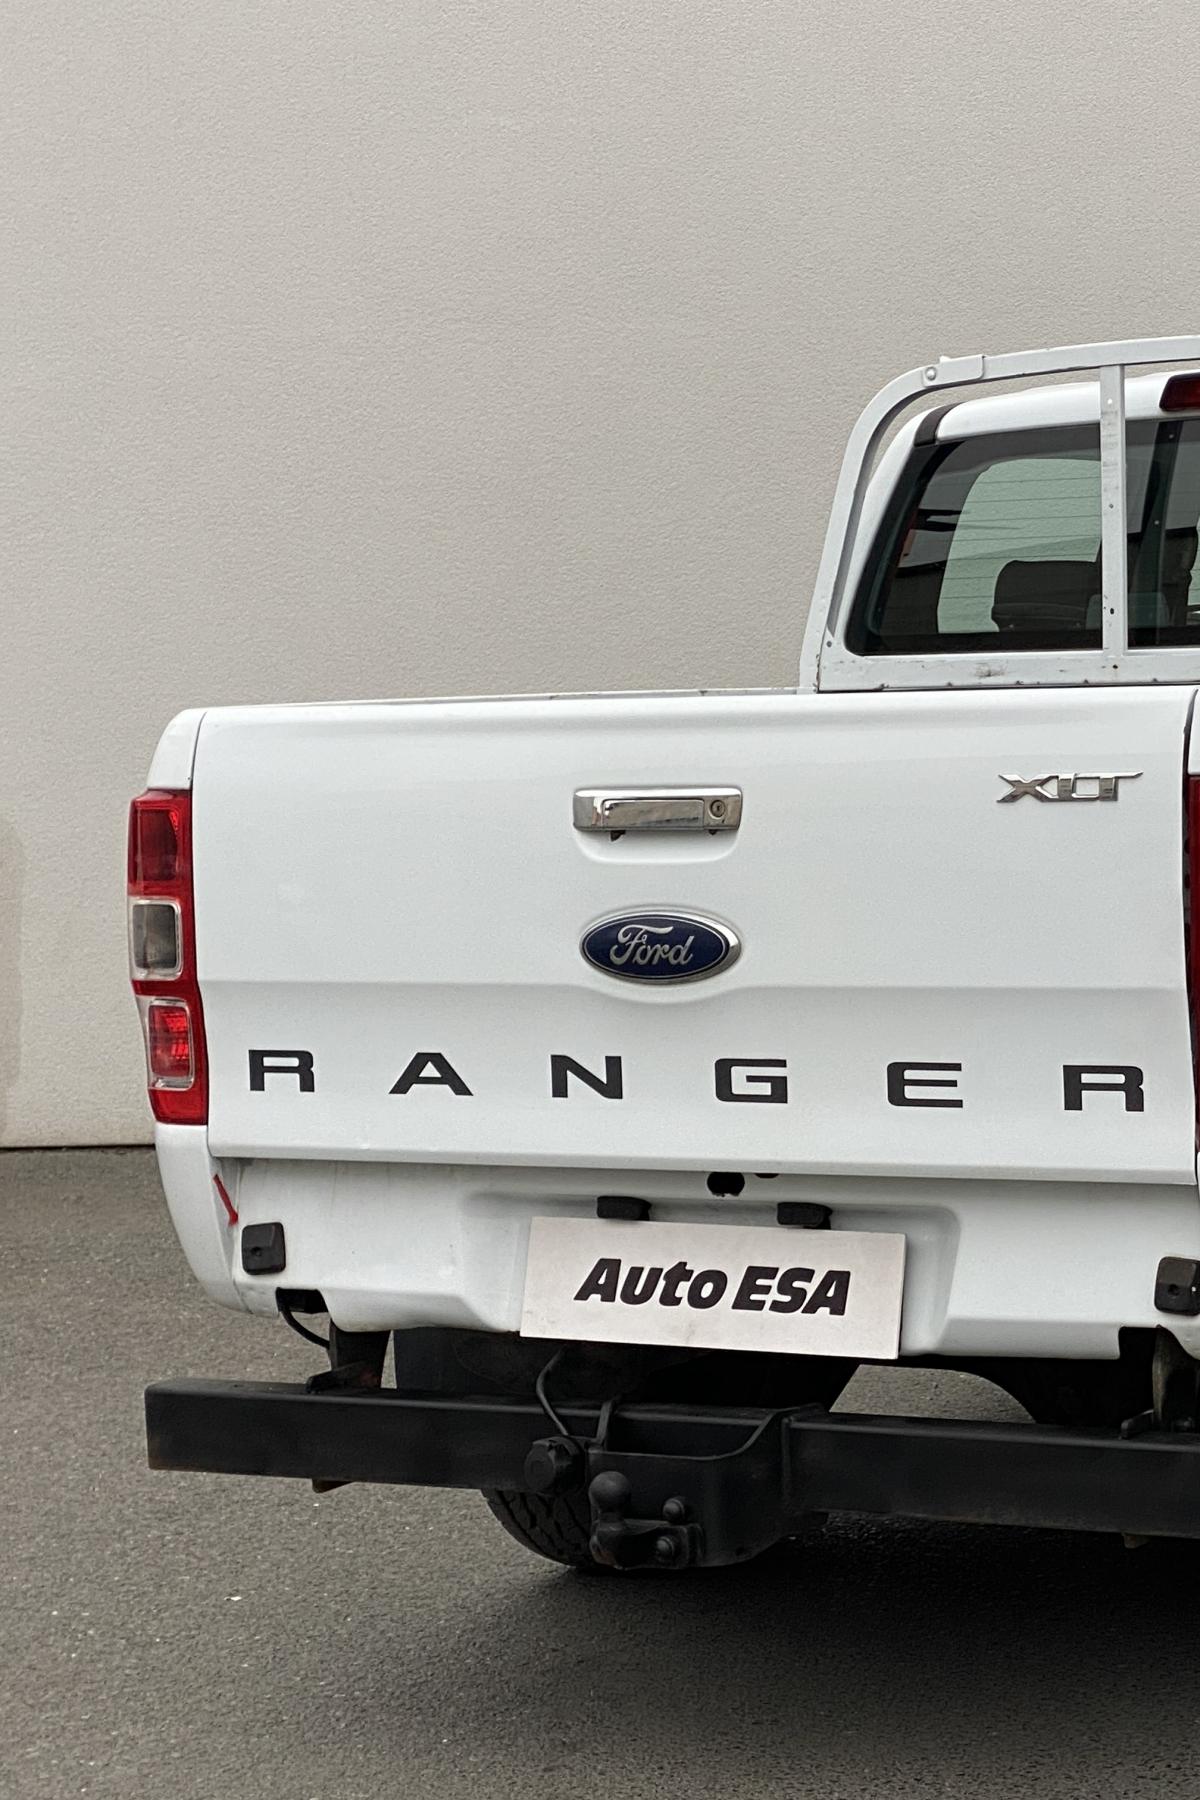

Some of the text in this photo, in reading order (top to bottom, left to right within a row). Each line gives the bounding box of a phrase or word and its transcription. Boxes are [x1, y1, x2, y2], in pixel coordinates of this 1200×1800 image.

[997, 771, 1143, 803] XLT
[609, 924, 695, 966] Ford
[248, 1050, 1145, 1112] RANGER
[573, 1257, 851, 1317] Auto ESA
